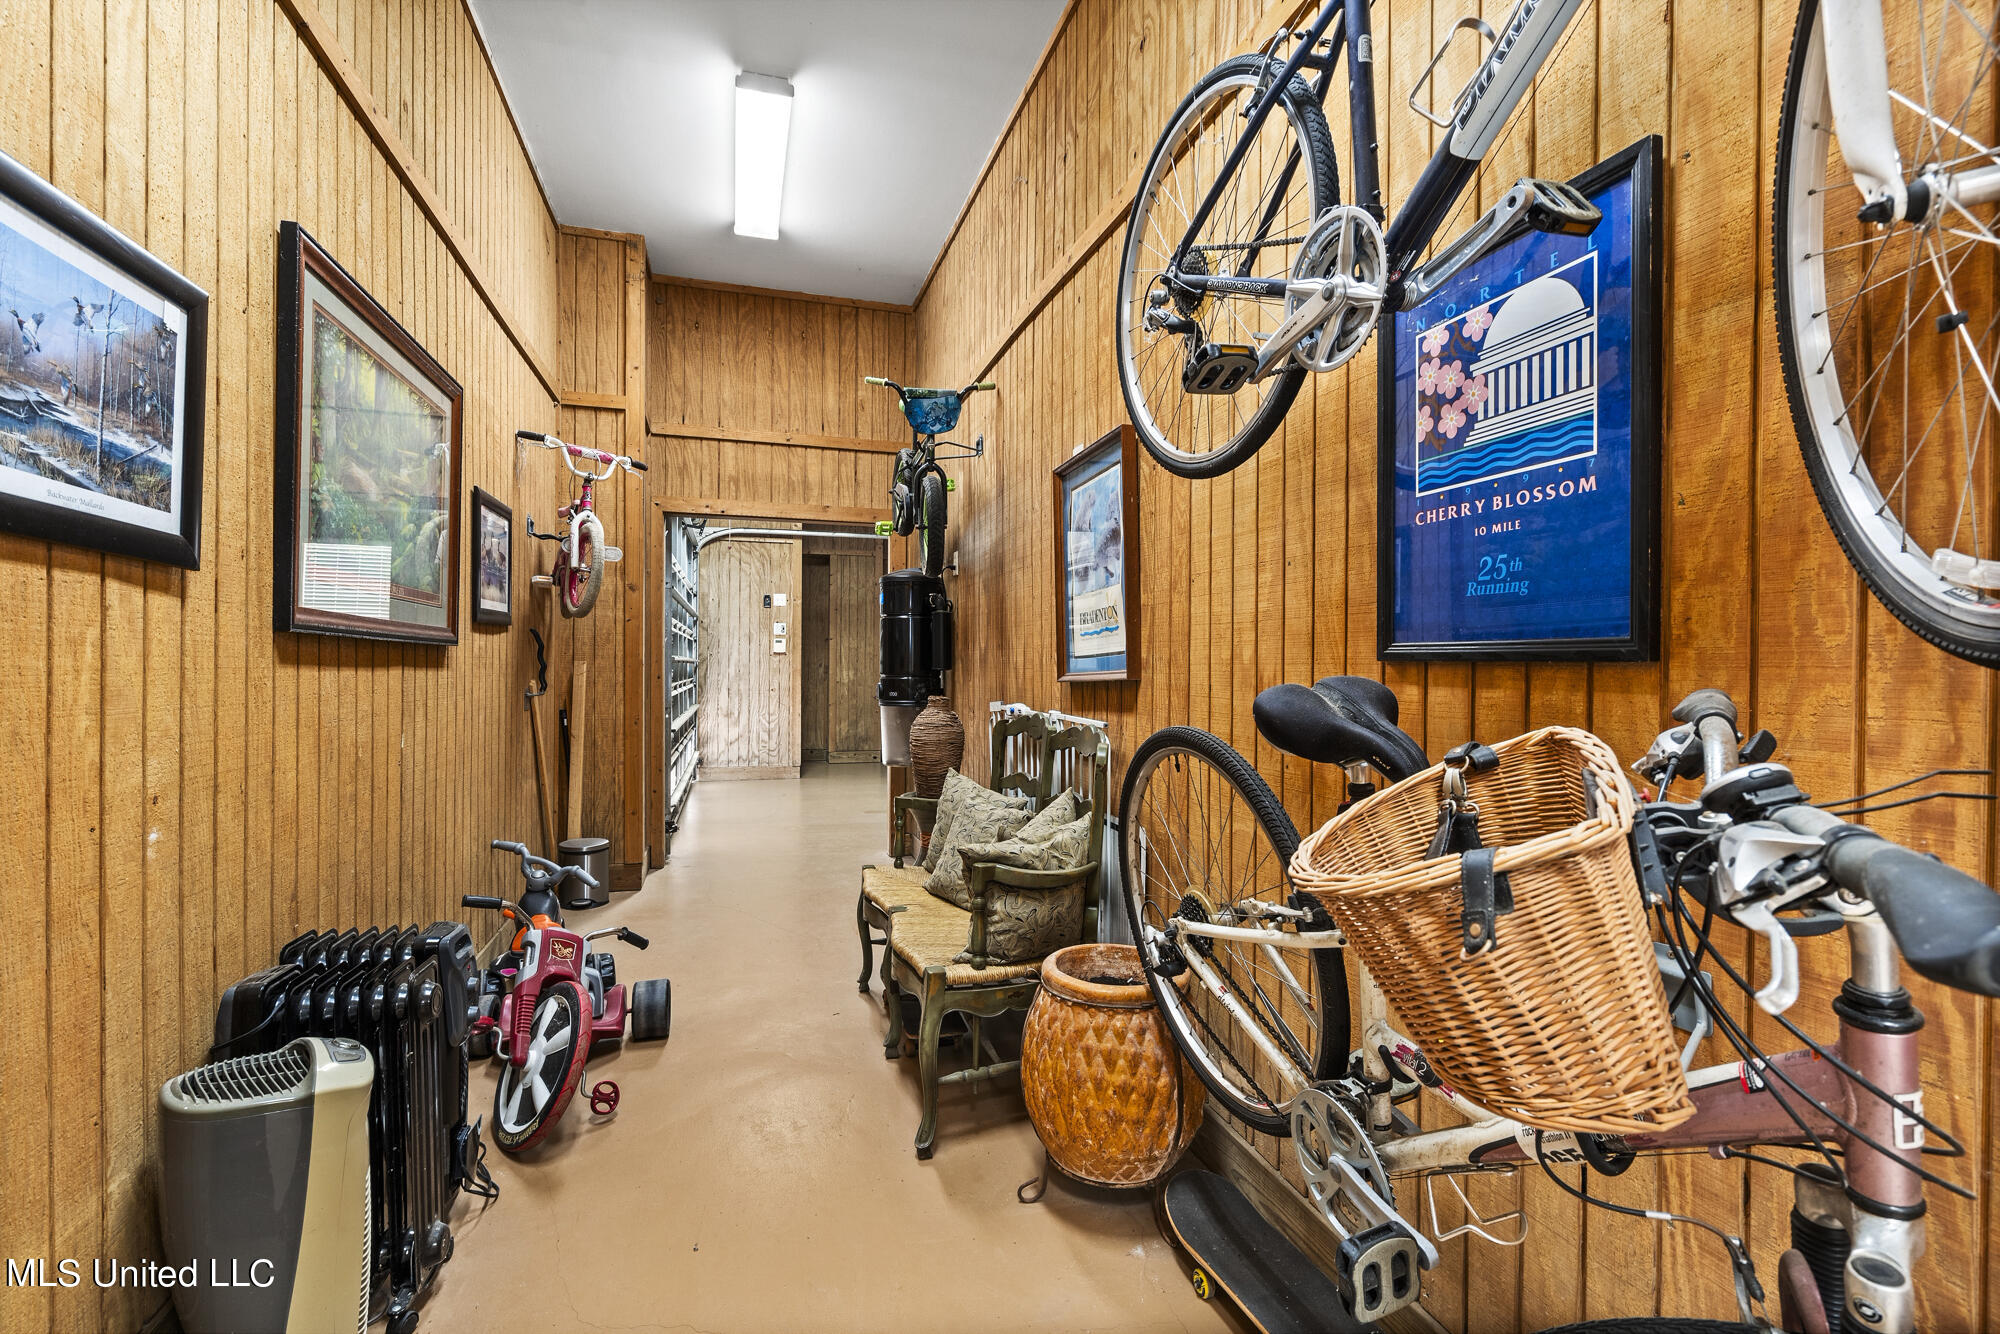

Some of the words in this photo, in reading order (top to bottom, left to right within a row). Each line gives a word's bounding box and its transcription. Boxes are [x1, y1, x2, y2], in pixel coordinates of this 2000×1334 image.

[1415, 498, 1486, 527] CHERRY
[1492, 475, 1598, 511] BLOSSOM
[1474, 526, 1487, 537] 10
[1491, 519, 1522, 534] MILE
[1477, 553, 1523, 581] 25th
[1465, 577, 1530, 597] Running
